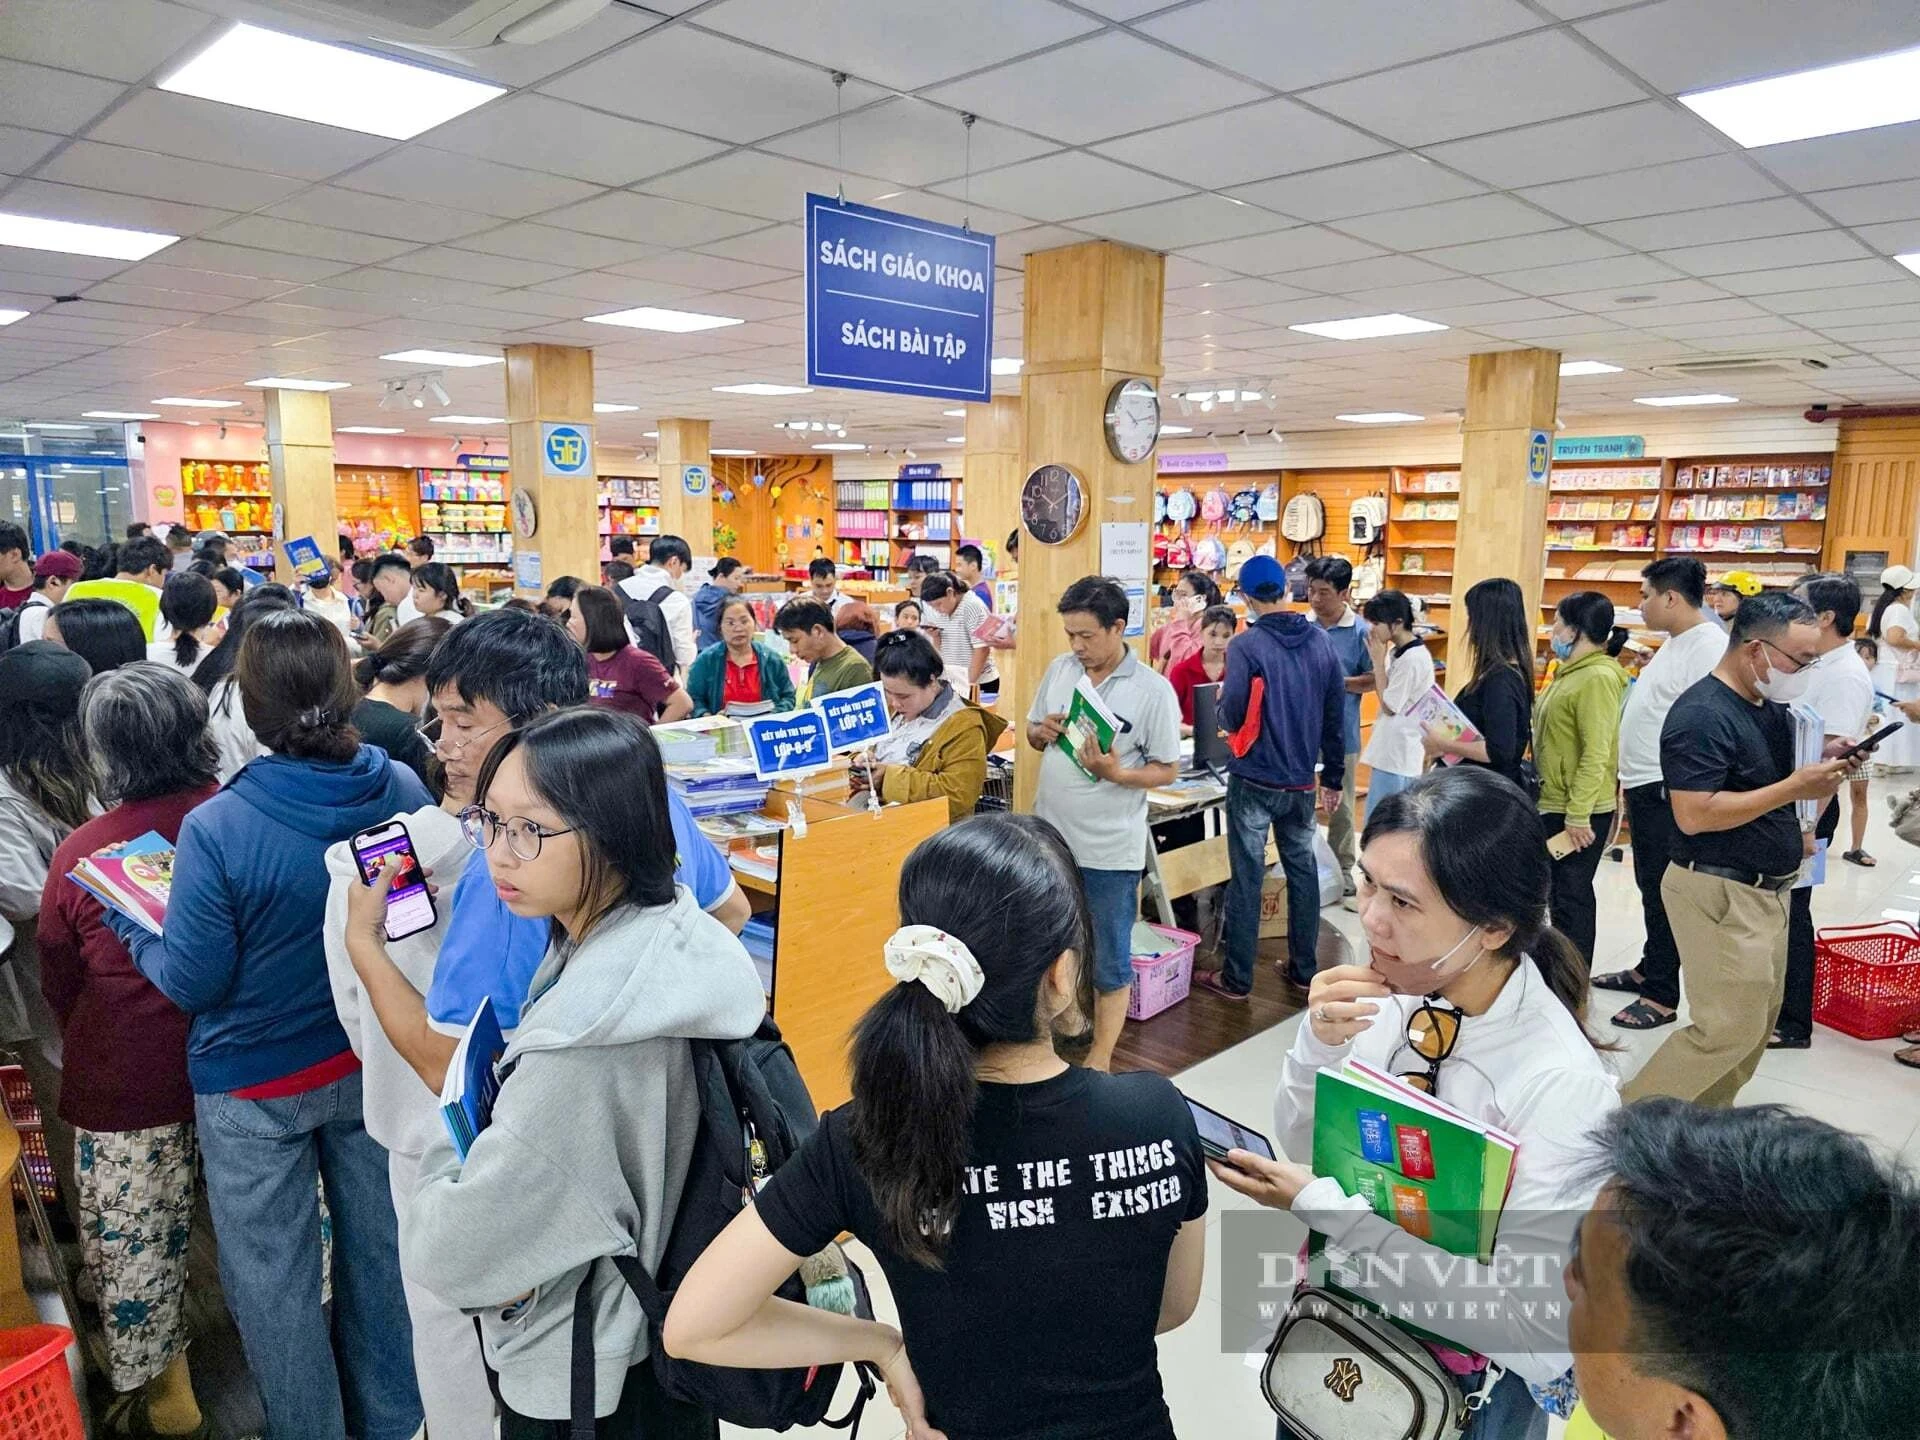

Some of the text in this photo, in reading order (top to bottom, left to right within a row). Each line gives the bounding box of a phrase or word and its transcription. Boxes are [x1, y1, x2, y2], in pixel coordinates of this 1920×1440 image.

[820, 238, 985, 293] SÁCH GIÁO KHOA
[841, 319, 966, 364] SÁCH BÀI TẬP
[1031, 513, 1038, 525] 8
[839, 710, 875, 731] LỚP 1-5
[962, 1139, 1176, 1194] TE THE THINGS
[986, 1197, 1056, 1230] WISH
[1091, 1175, 1181, 1220] EXISTED
